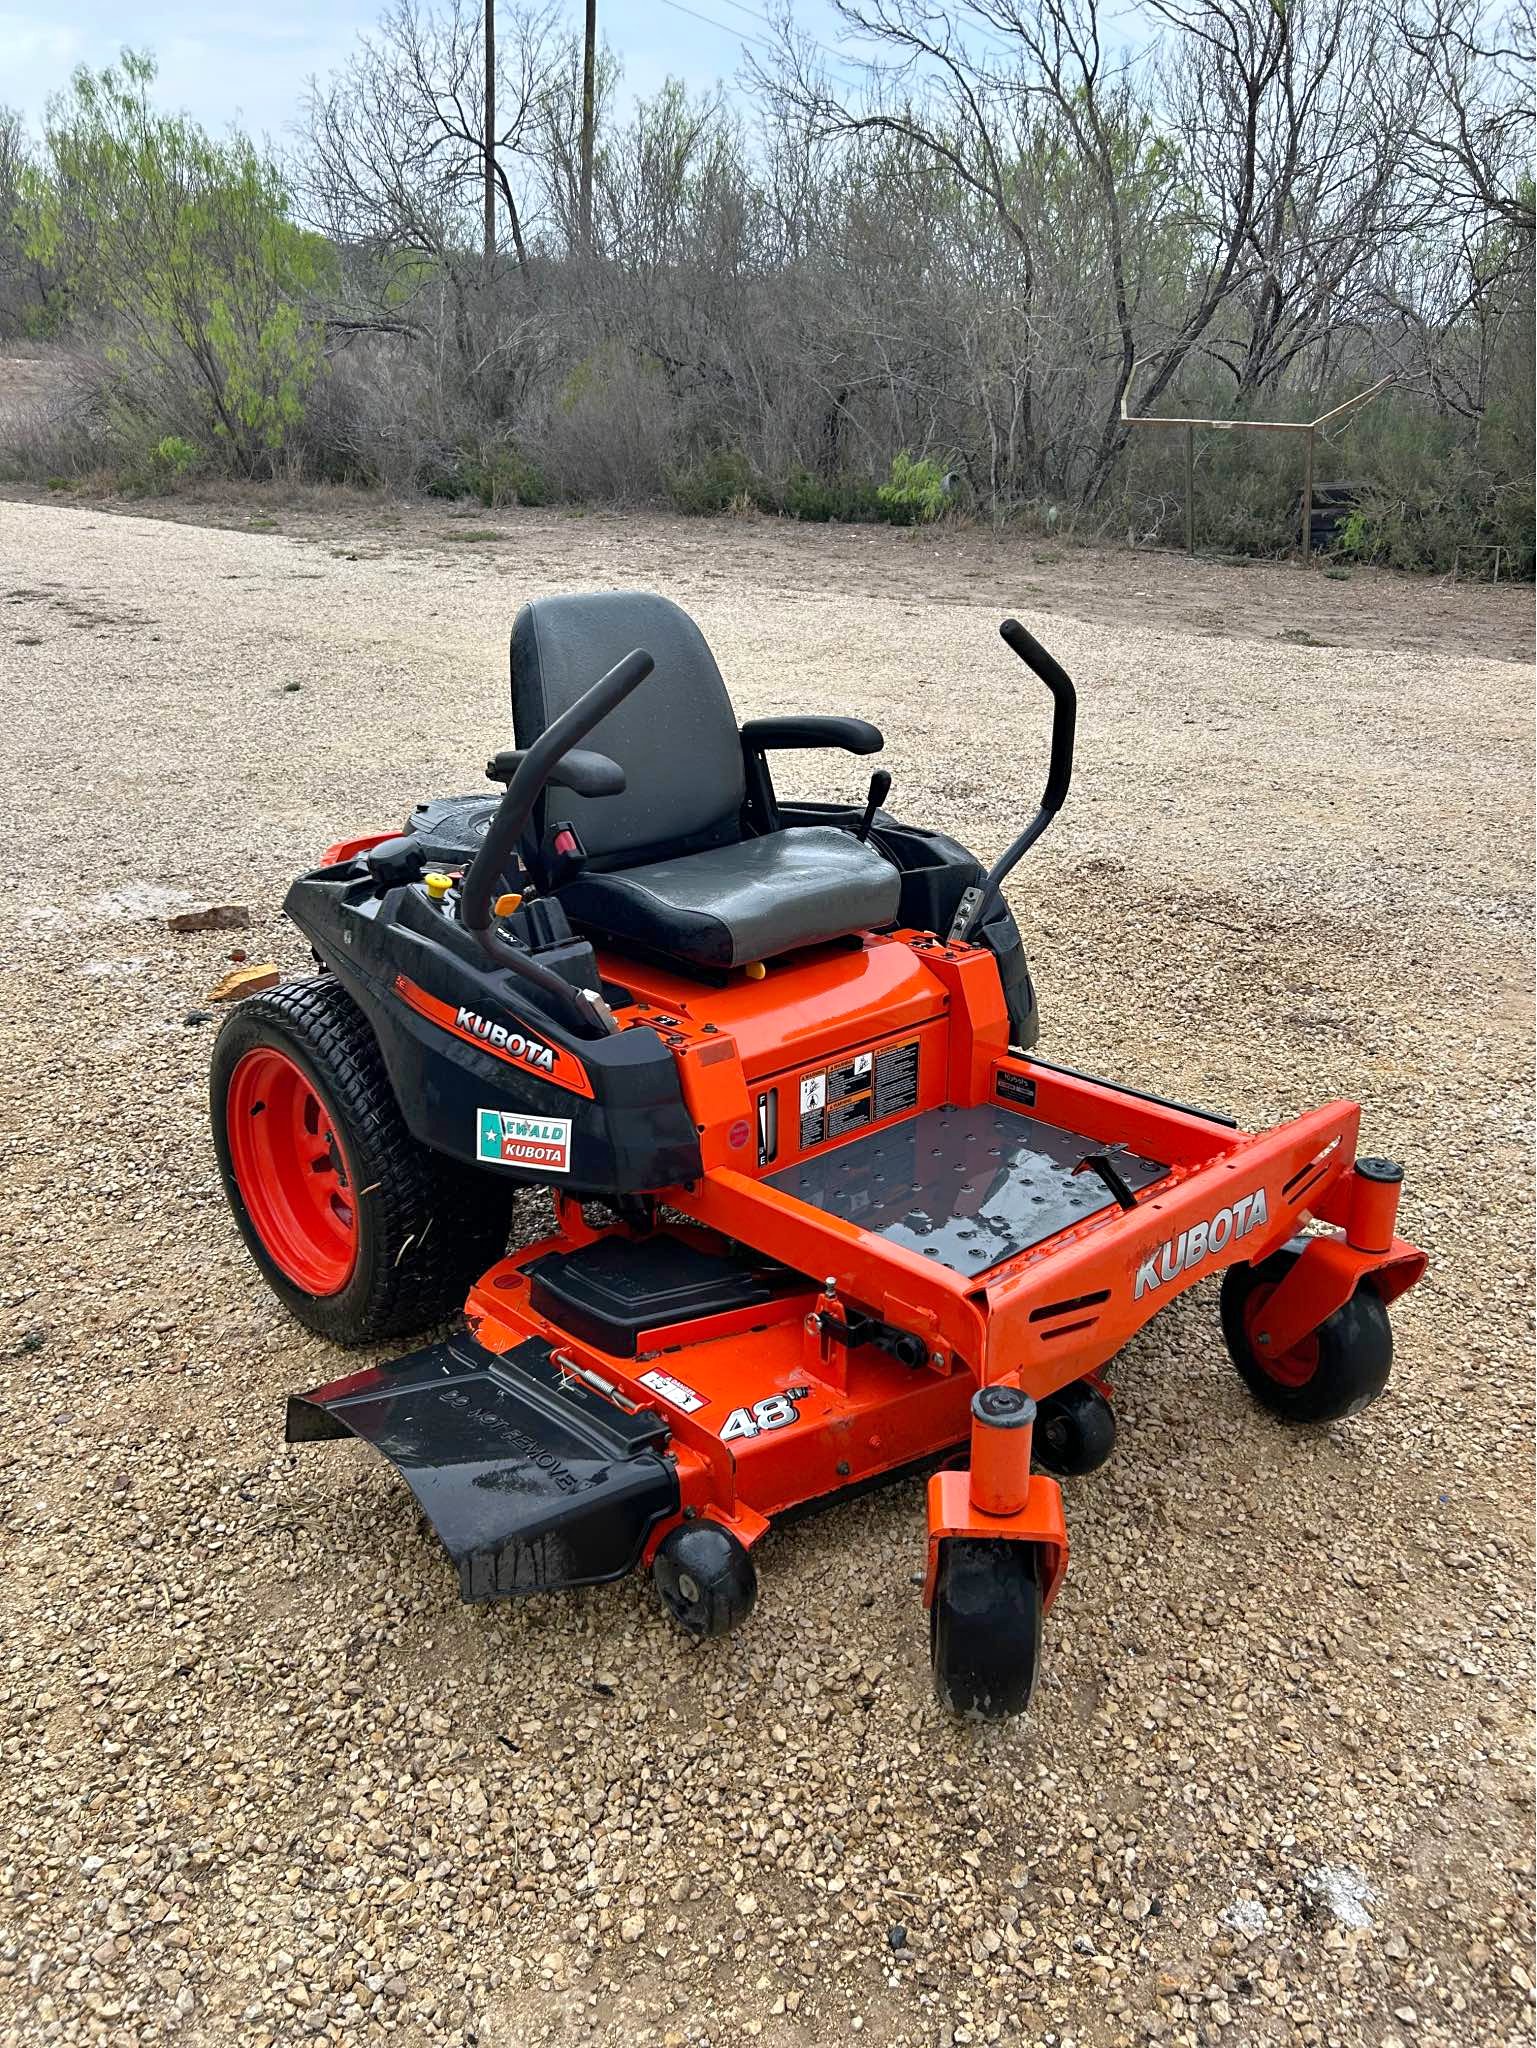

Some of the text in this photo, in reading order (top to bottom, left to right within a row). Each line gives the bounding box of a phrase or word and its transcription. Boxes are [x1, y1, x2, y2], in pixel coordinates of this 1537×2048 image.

[455, 1006, 555, 1072] KUBOTA
[759, 1095, 766, 1105] F
[505, 1120, 564, 1141] EWALD
[505, 1143, 562, 1162] KUBOTA
[760, 1156, 766, 1165] E
[1133, 1187, 1268, 1300] KUBOTA
[719, 1395, 799, 1441] 48
[439, 1388, 578, 1492] DO NOT REMOVE
